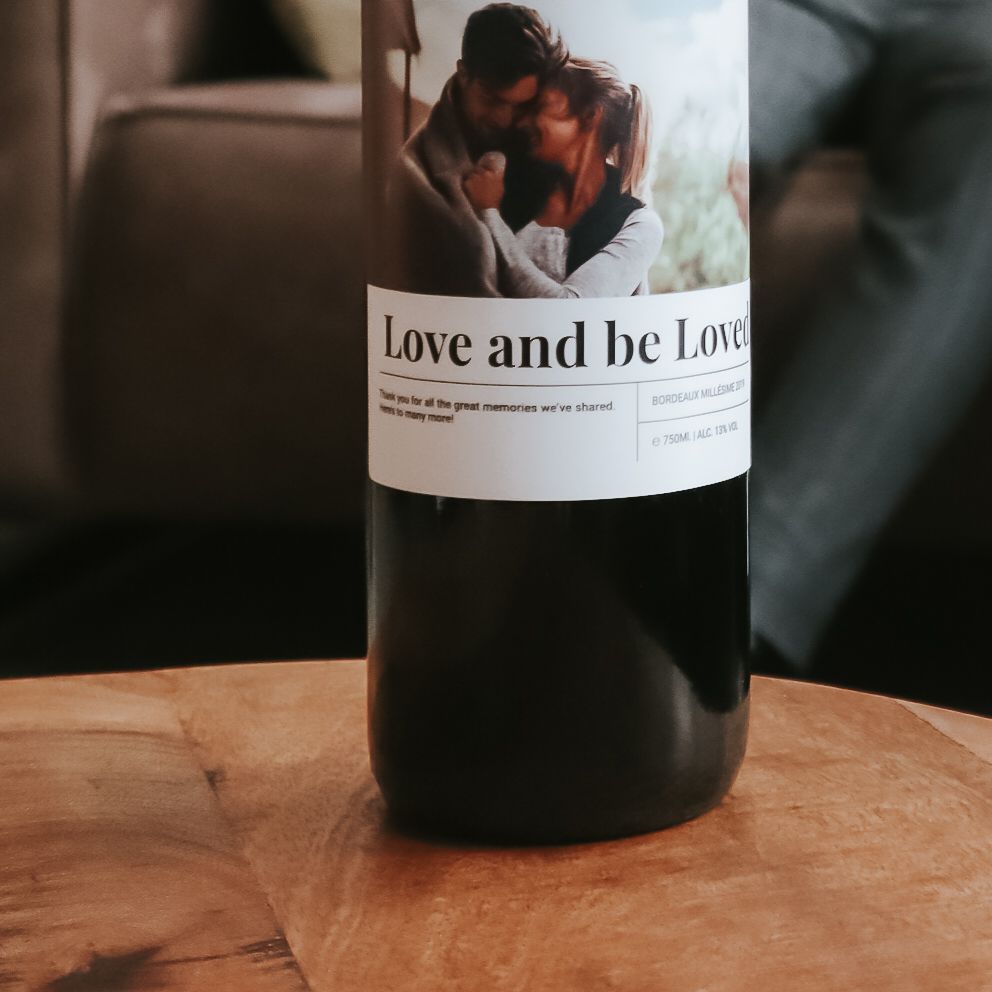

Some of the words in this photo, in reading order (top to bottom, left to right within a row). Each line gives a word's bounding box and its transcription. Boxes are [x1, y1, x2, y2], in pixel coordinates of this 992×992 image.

[384, 314, 472, 367] Love
[488, 320, 588, 369] and
[604, 320, 661, 368] be
[674, 300, 749, 362] Loved
[397, 394, 409, 405] you
[411, 395, 422, 406] for
[424, 397, 434, 407] all
[437, 398, 451, 408] the
[454, 401, 479, 413] great
[483, 402, 537, 413] memories
[541, 402, 572, 413] we've
[652, 390, 700, 407] BORDEAUX
[405, 410, 425, 423] many
[428, 413, 454, 424] more!
[715, 424, 728, 436] 13%
